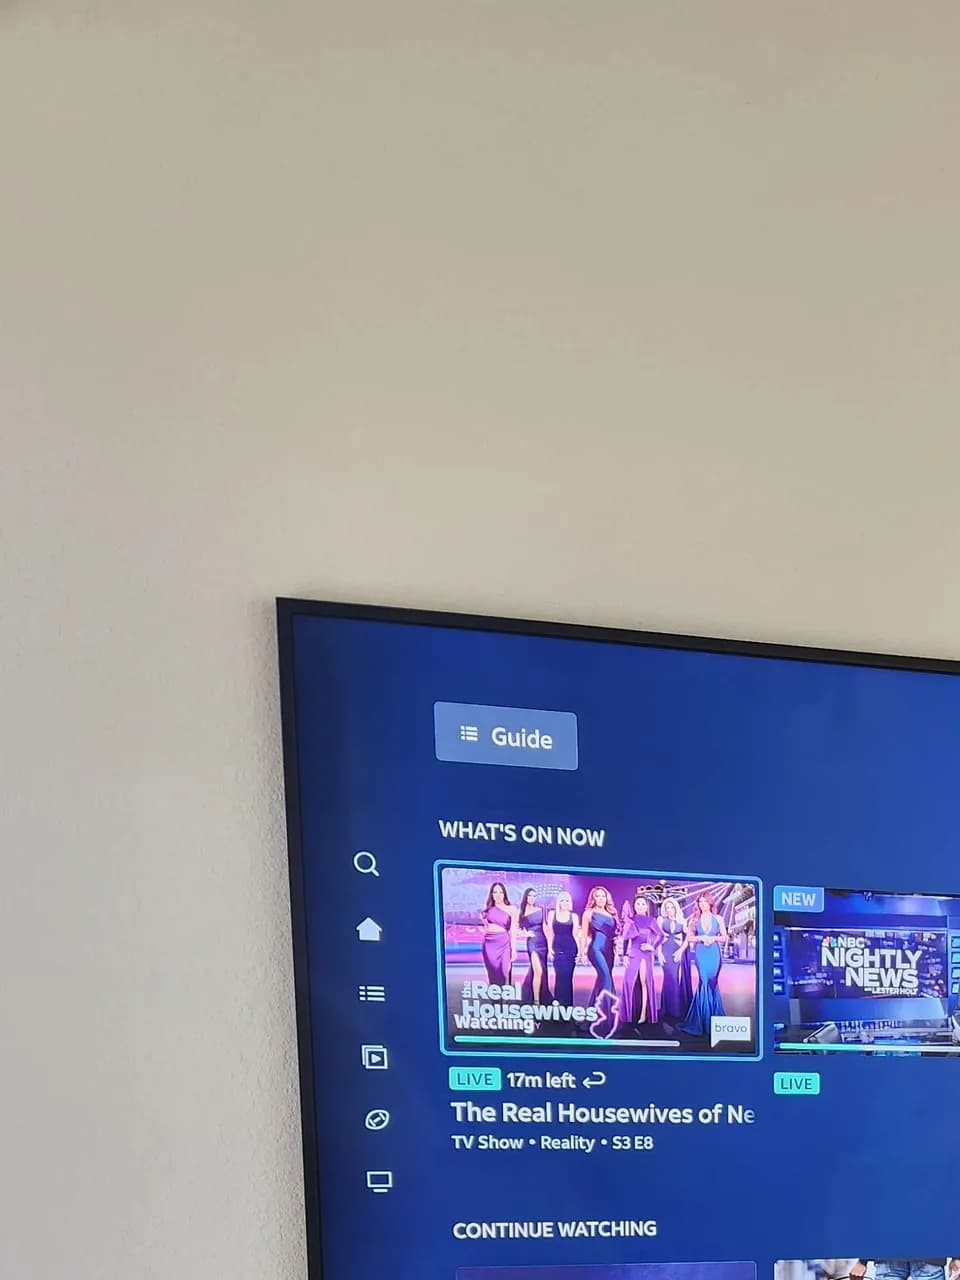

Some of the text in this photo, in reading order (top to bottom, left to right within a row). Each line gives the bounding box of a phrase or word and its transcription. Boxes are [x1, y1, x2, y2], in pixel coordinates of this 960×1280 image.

[491, 727, 553, 750] Guide
[438, 819, 605, 847] WHAT'S ON NOW
[781, 891, 816, 907] NEW
[838, 936, 865, 949] NBC
[821, 947, 922, 970] NIGHTLY
[845, 967, 919, 988] NEWS
[472, 980, 522, 1001] Real
[462, 999, 600, 1022] Housewives
[454, 1014, 535, 1034] Watching
[714, 1022, 748, 1034] bravo
[457, 1071, 576, 1089] LIVE 17m left
[781, 1077, 812, 1090] LIVE
[451, 1101, 496, 1123] The
[502, 1101, 551, 1123] Real
[558, 1103, 693, 1125] Housewives
[698, 1104, 721, 1124] of
[452, 1135, 654, 1153] TV Show Reality S3 E8
[452, 1220, 657, 1239] CONTINUE WATCHING
